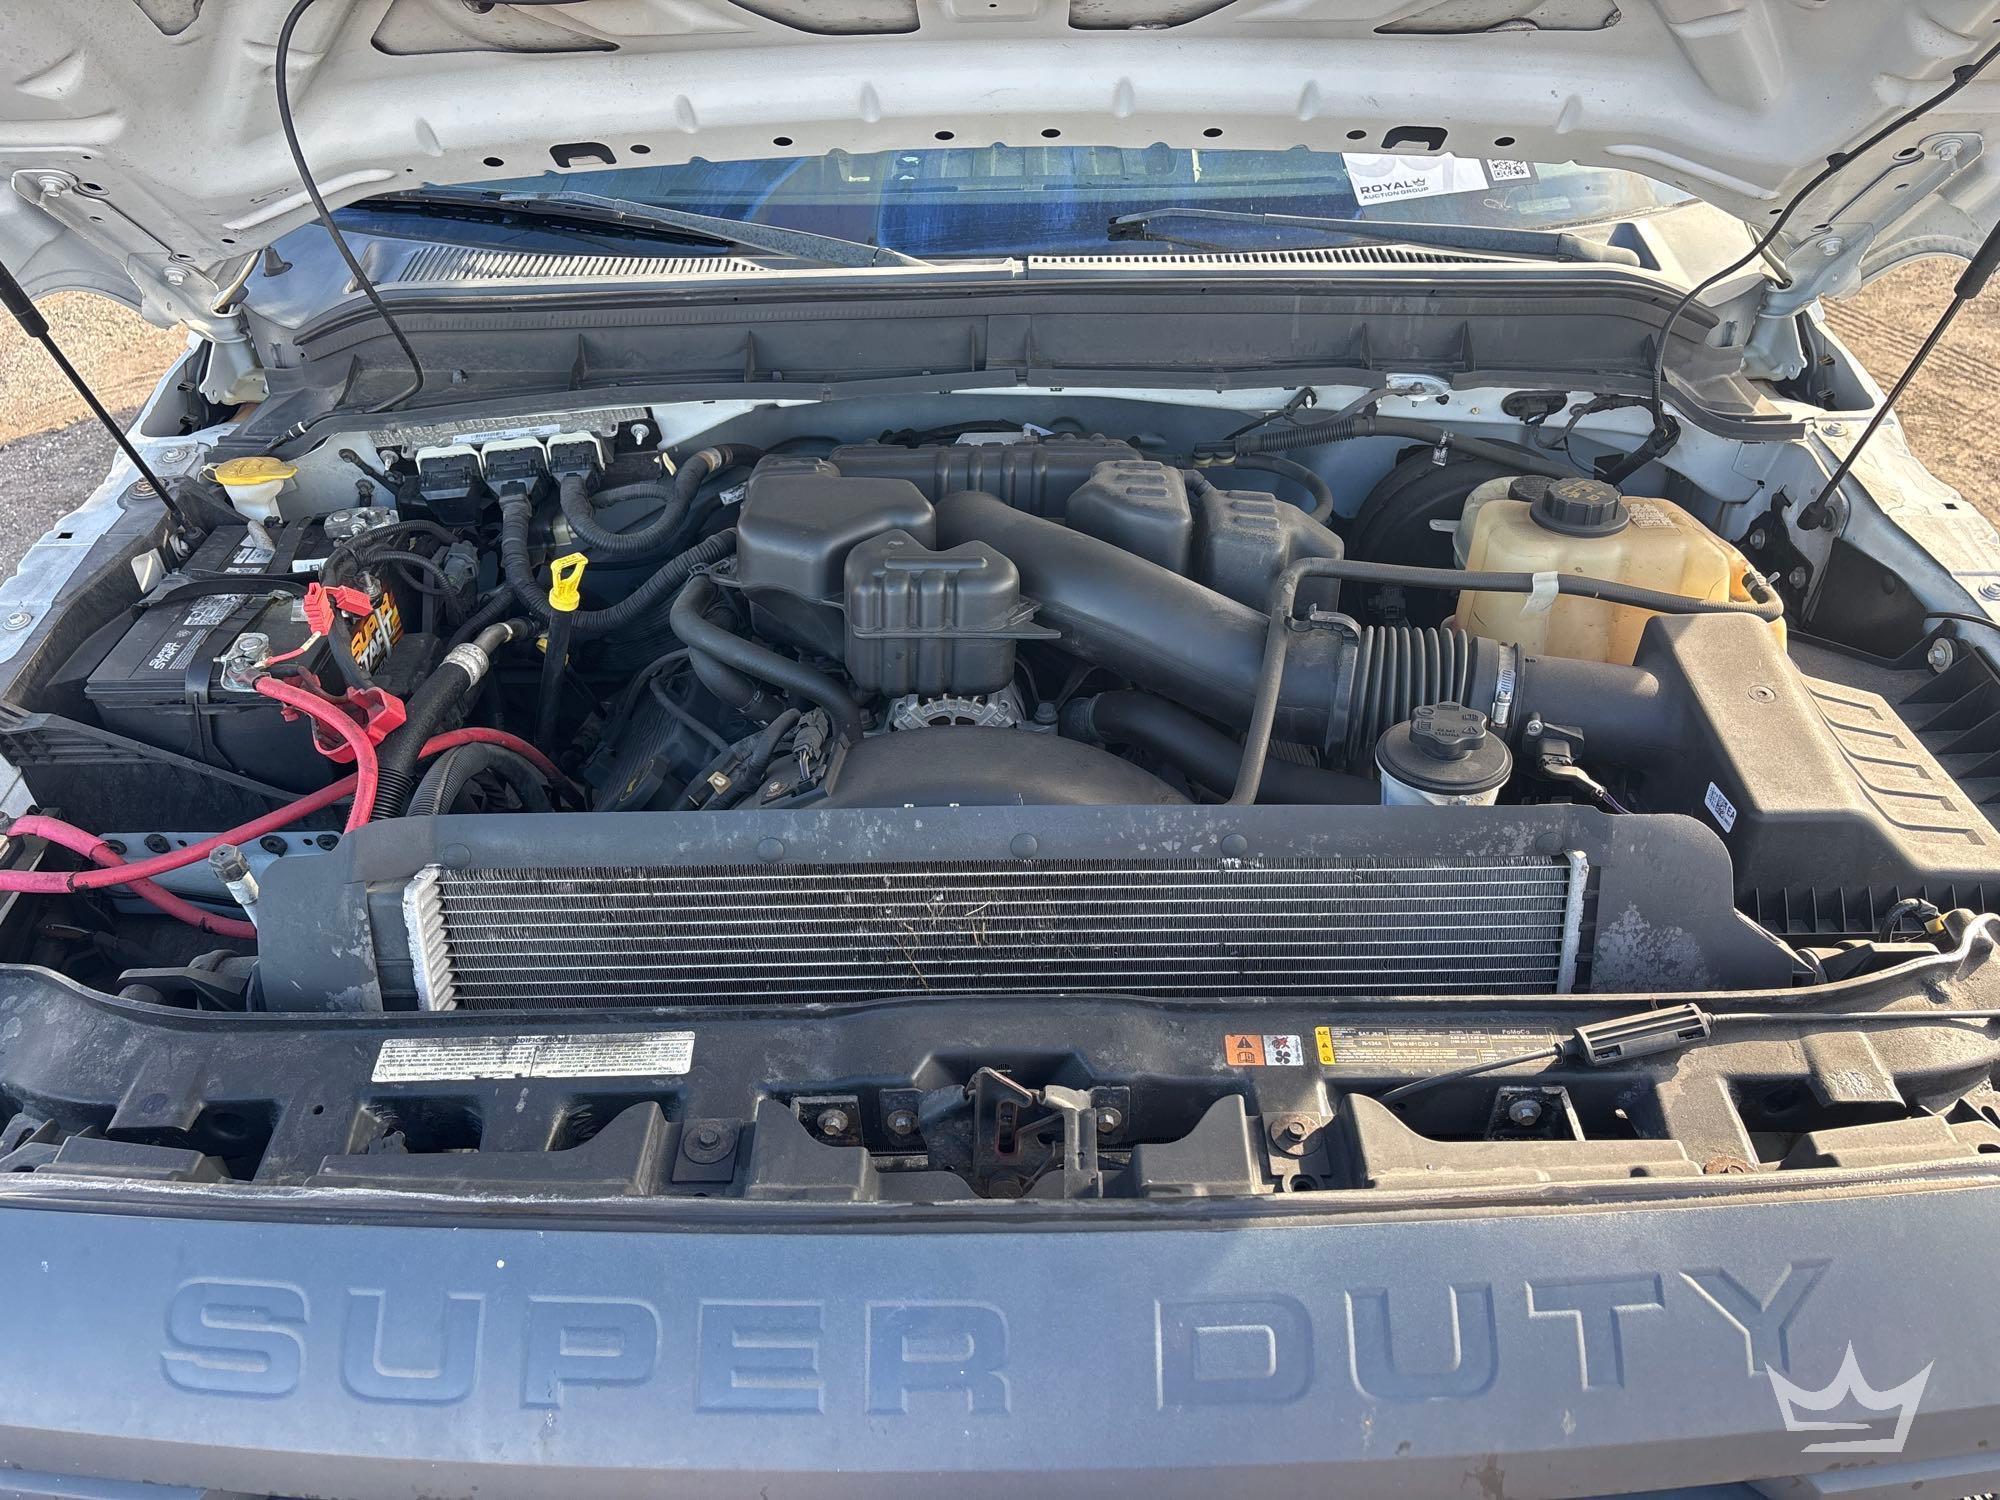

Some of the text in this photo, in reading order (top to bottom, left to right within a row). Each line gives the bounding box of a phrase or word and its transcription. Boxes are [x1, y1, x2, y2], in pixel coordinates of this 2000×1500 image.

[1360, 180, 1413, 195] ROYAL
[1363, 186, 1429, 200] AUCTION GROUP
[148, 642, 175, 667] SUPER
[153, 642, 182, 670] START
[160, 1258, 1833, 1414] SUPER DUTY
